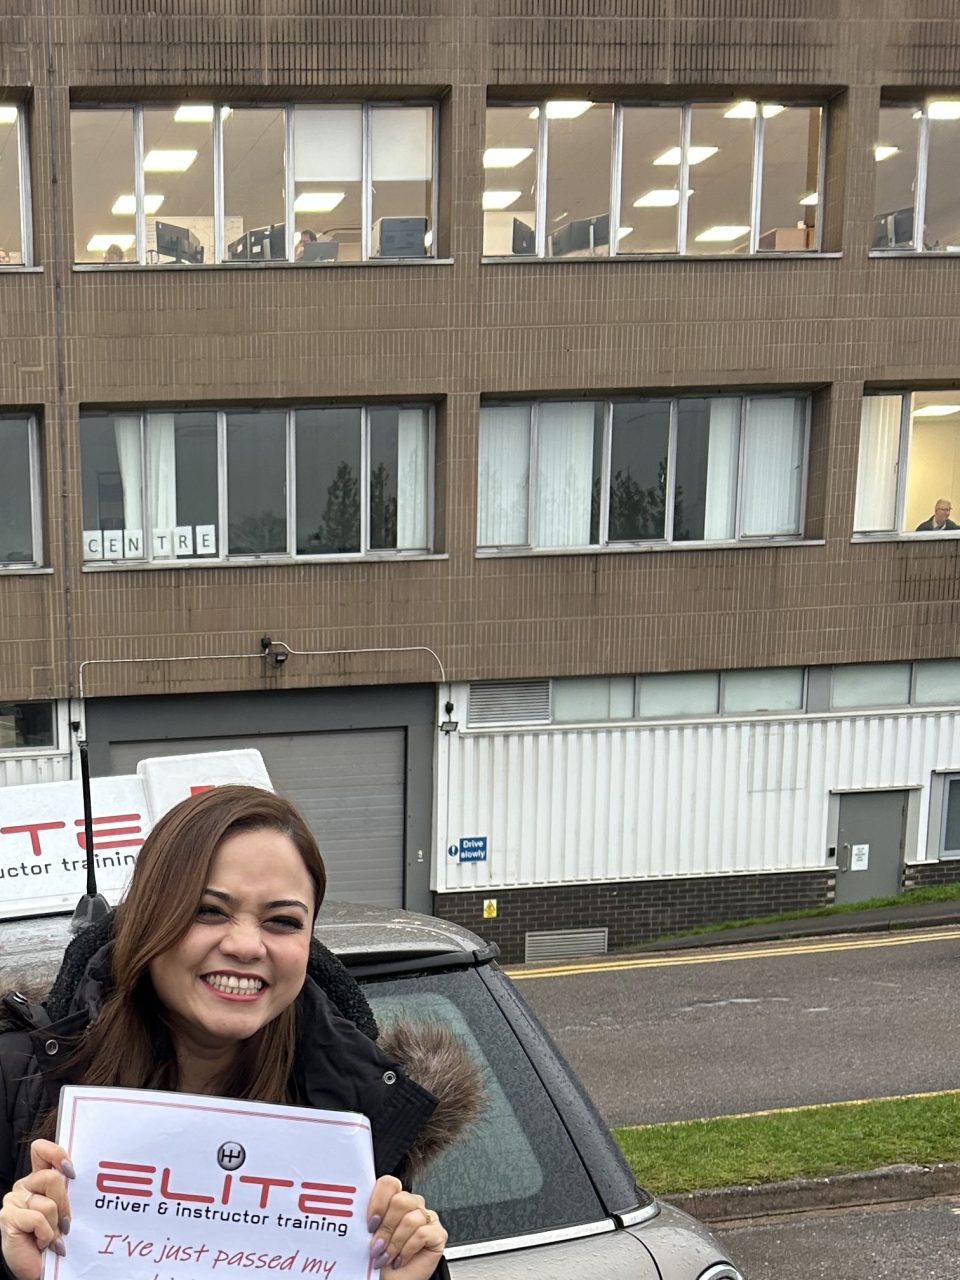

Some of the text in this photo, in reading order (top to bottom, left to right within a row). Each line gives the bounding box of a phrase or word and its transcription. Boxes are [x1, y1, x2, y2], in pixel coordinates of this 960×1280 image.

[88, 533, 210, 553] CENTRE
[461, 850, 485, 859] slowly
[463, 840, 483, 849] Drive
[61, 851, 136, 872] trainin
[95, 1194, 348, 1236] driver & instructor training
[97, 1233, 337, 1280] I've just passed my
